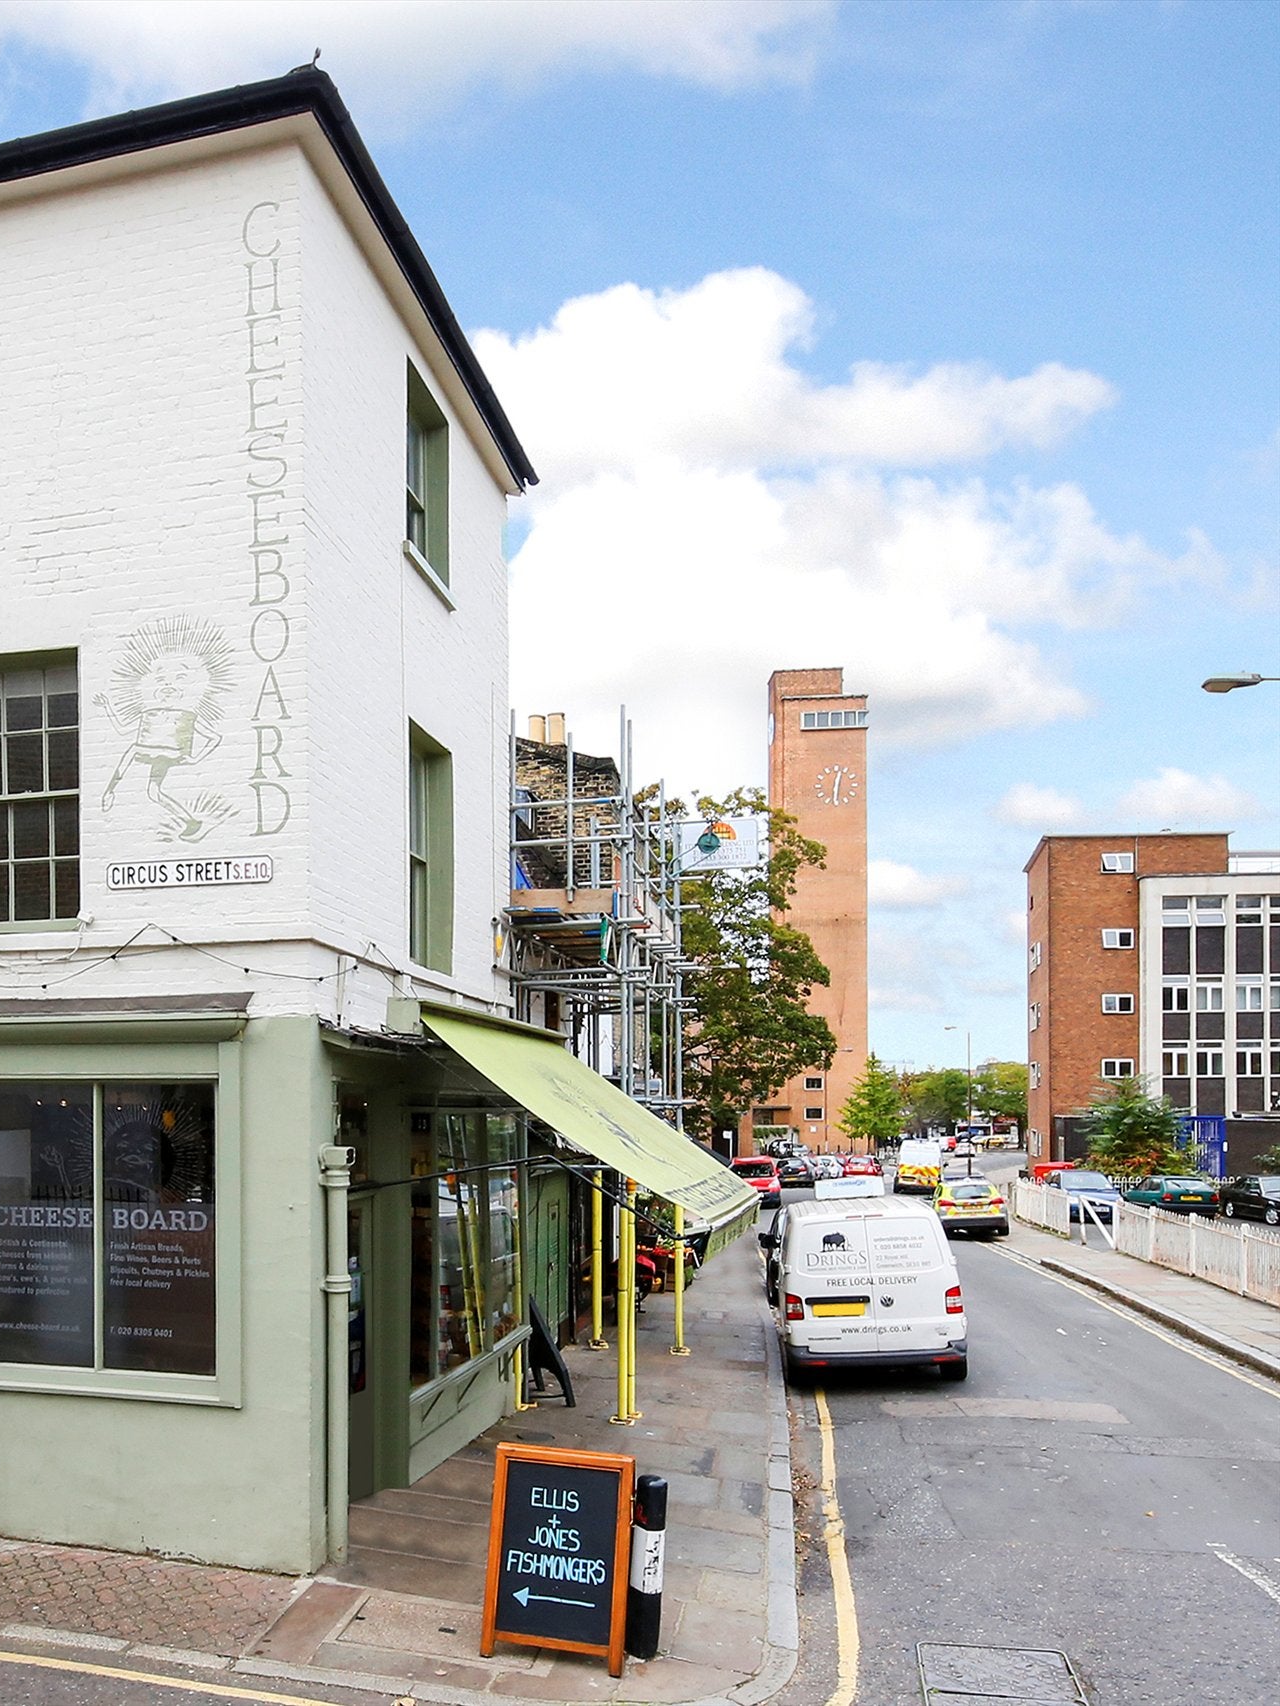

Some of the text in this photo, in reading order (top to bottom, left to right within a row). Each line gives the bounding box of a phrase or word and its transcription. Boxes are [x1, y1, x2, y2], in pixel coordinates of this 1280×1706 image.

[242, 201, 292, 836] CHEESEBOARD
[111, 864, 168, 885] CIRCUS
[176, 861, 232, 882] STREET
[112, 1208, 208, 1232] BOARD
[21, 1239, 27, 1247] &
[110, 1241, 184, 1253] Fresh Artisan Breads,
[26, 1250, 42, 1259] from
[110, 1253, 201, 1265] Fine Wines, Beers & Ports
[806, 1250, 867, 1267] DRINGS
[18, 1262, 24, 1270] &
[26, 1262, 49, 1271] dairies
[142, 1267, 174, 1277] Chutneys
[175, 1268, 182, 1277] &
[184, 1269, 210, 1278] Pickles
[110, 1278, 172, 1290] free local delivery
[826, 1276, 918, 1287] FREE LOCAL DELIVERY
[27, 1286, 34, 1294] to
[117, 1326, 132, 1335] 020
[133, 1327, 153, 1336] 8305
[154, 1328, 173, 1338] 0401
[841, 1324, 912, 1335] www.drings.co.uk
[530, 1487, 580, 1513] ELLIS
[527, 1525, 581, 1552] JONES
[506, 1550, 606, 1585] FISHMONGERS
